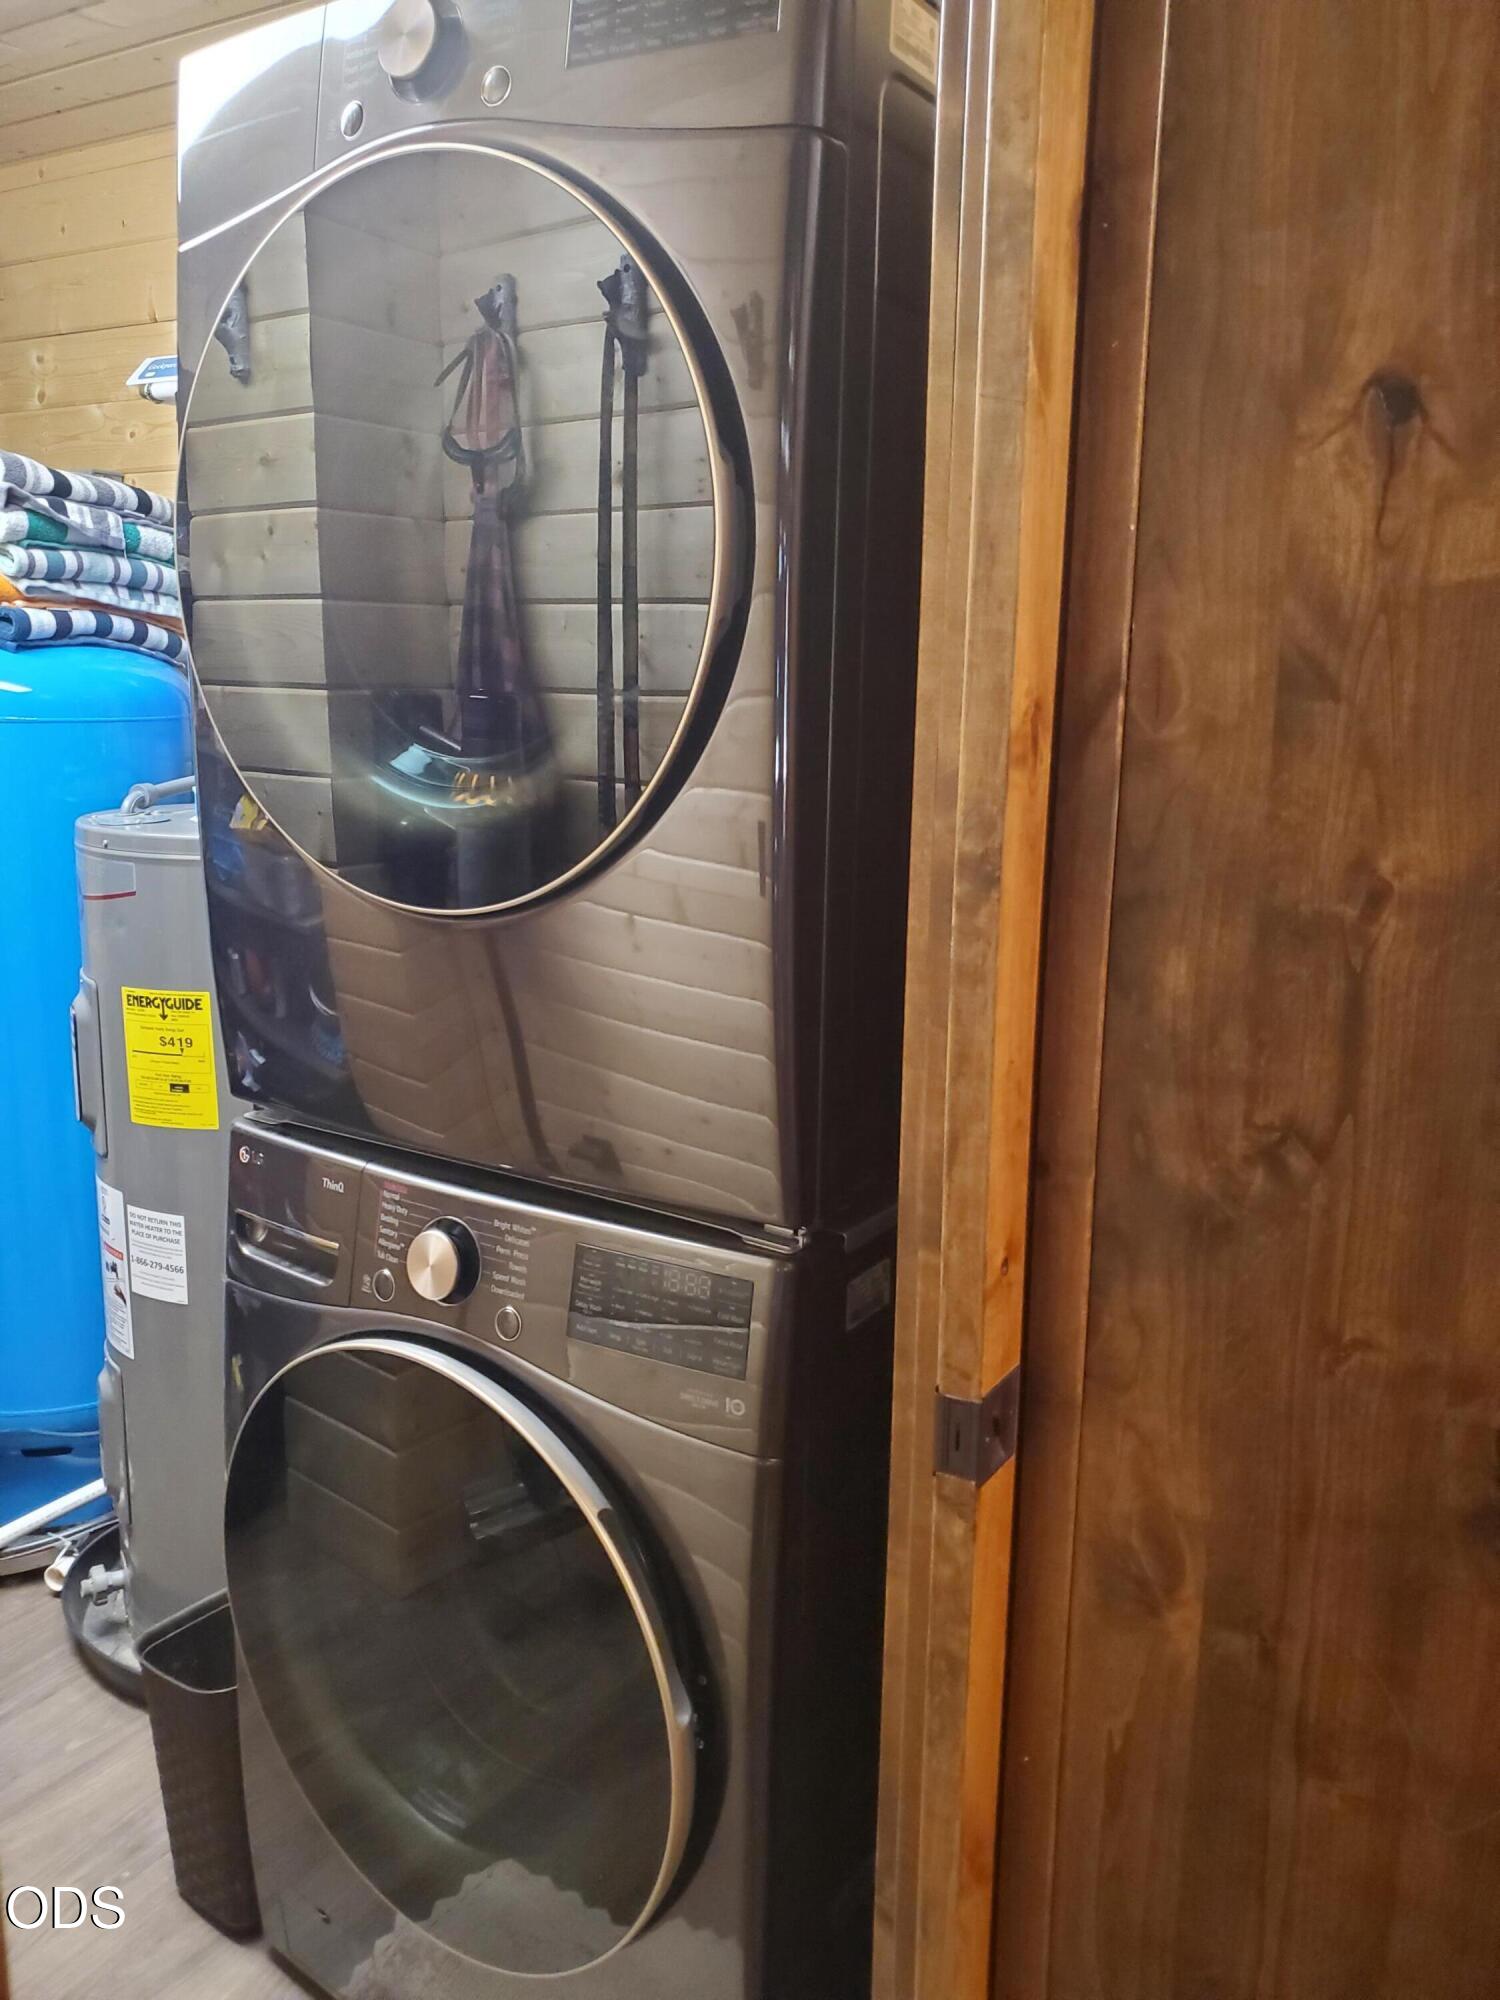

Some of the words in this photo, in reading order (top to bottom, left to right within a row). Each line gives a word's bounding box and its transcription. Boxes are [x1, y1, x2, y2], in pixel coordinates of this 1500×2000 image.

[126, 994, 203, 1011] ENERGYGUIDE
[322, 1177, 345, 1193] ThinQ
[129, 1220, 144, 1230] WATER
[144, 1223, 163, 1233] HEATER
[172, 1229, 183, 1237] THE
[137, 1213, 147, 1221] NOT
[147, 1216, 168, 1227] RETURN
[169, 1220, 182, 1229] THIS
[131, 1229, 145, 1239] PLACE
[152, 1234, 181, 1246] PURCHASE
[130, 1254, 185, 1275] 1-866-279-4566
